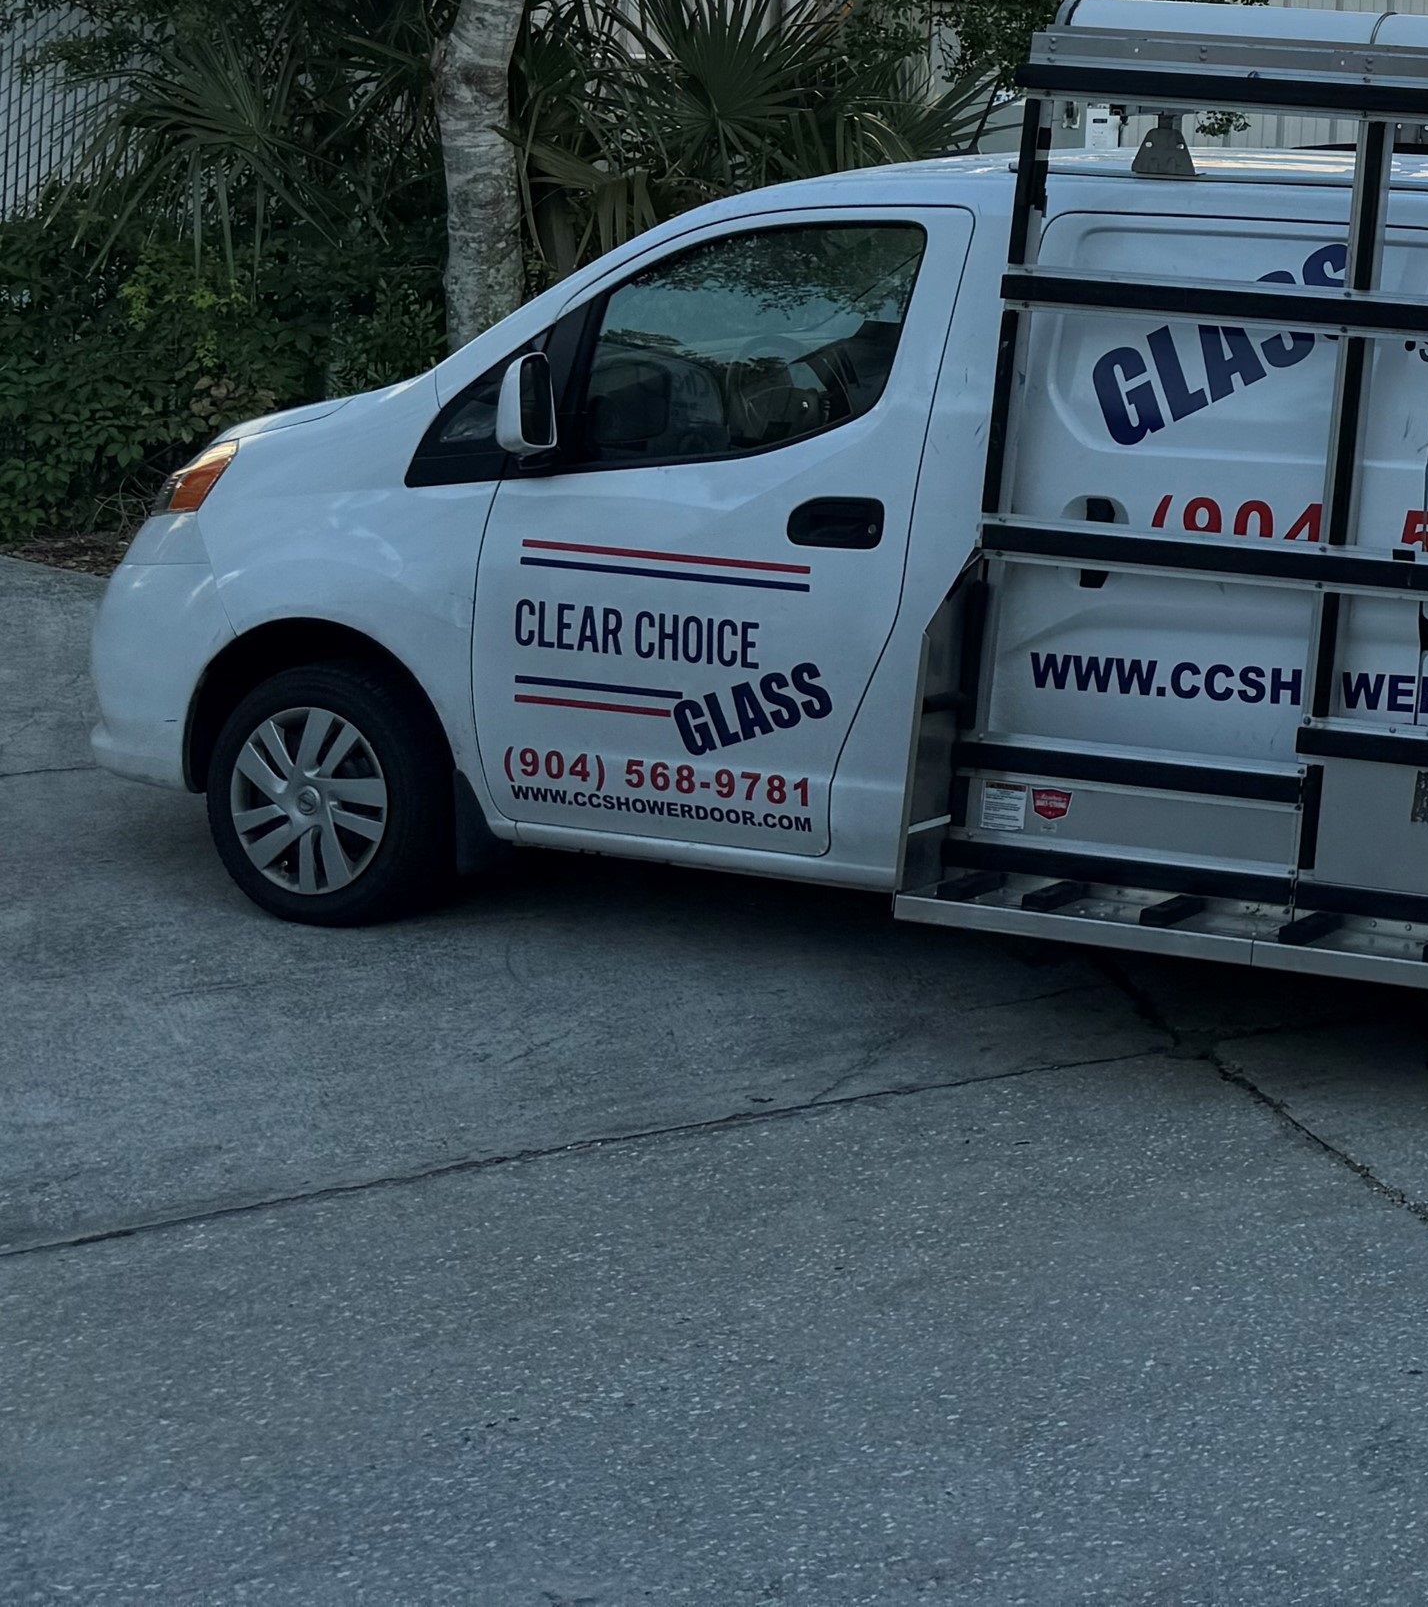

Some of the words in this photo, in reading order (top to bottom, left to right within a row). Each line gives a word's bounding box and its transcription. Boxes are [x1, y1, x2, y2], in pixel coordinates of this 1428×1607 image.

[514, 598, 623, 656] CLEAR
[634, 610, 761, 670] CHOICE
[673, 661, 833, 757] GLASS
[504, 746, 606, 791] (904)
[625, 759, 810, 808] 568-9781
[510, 784, 813, 833] WWW.CCSHOWERDOOR.COM
